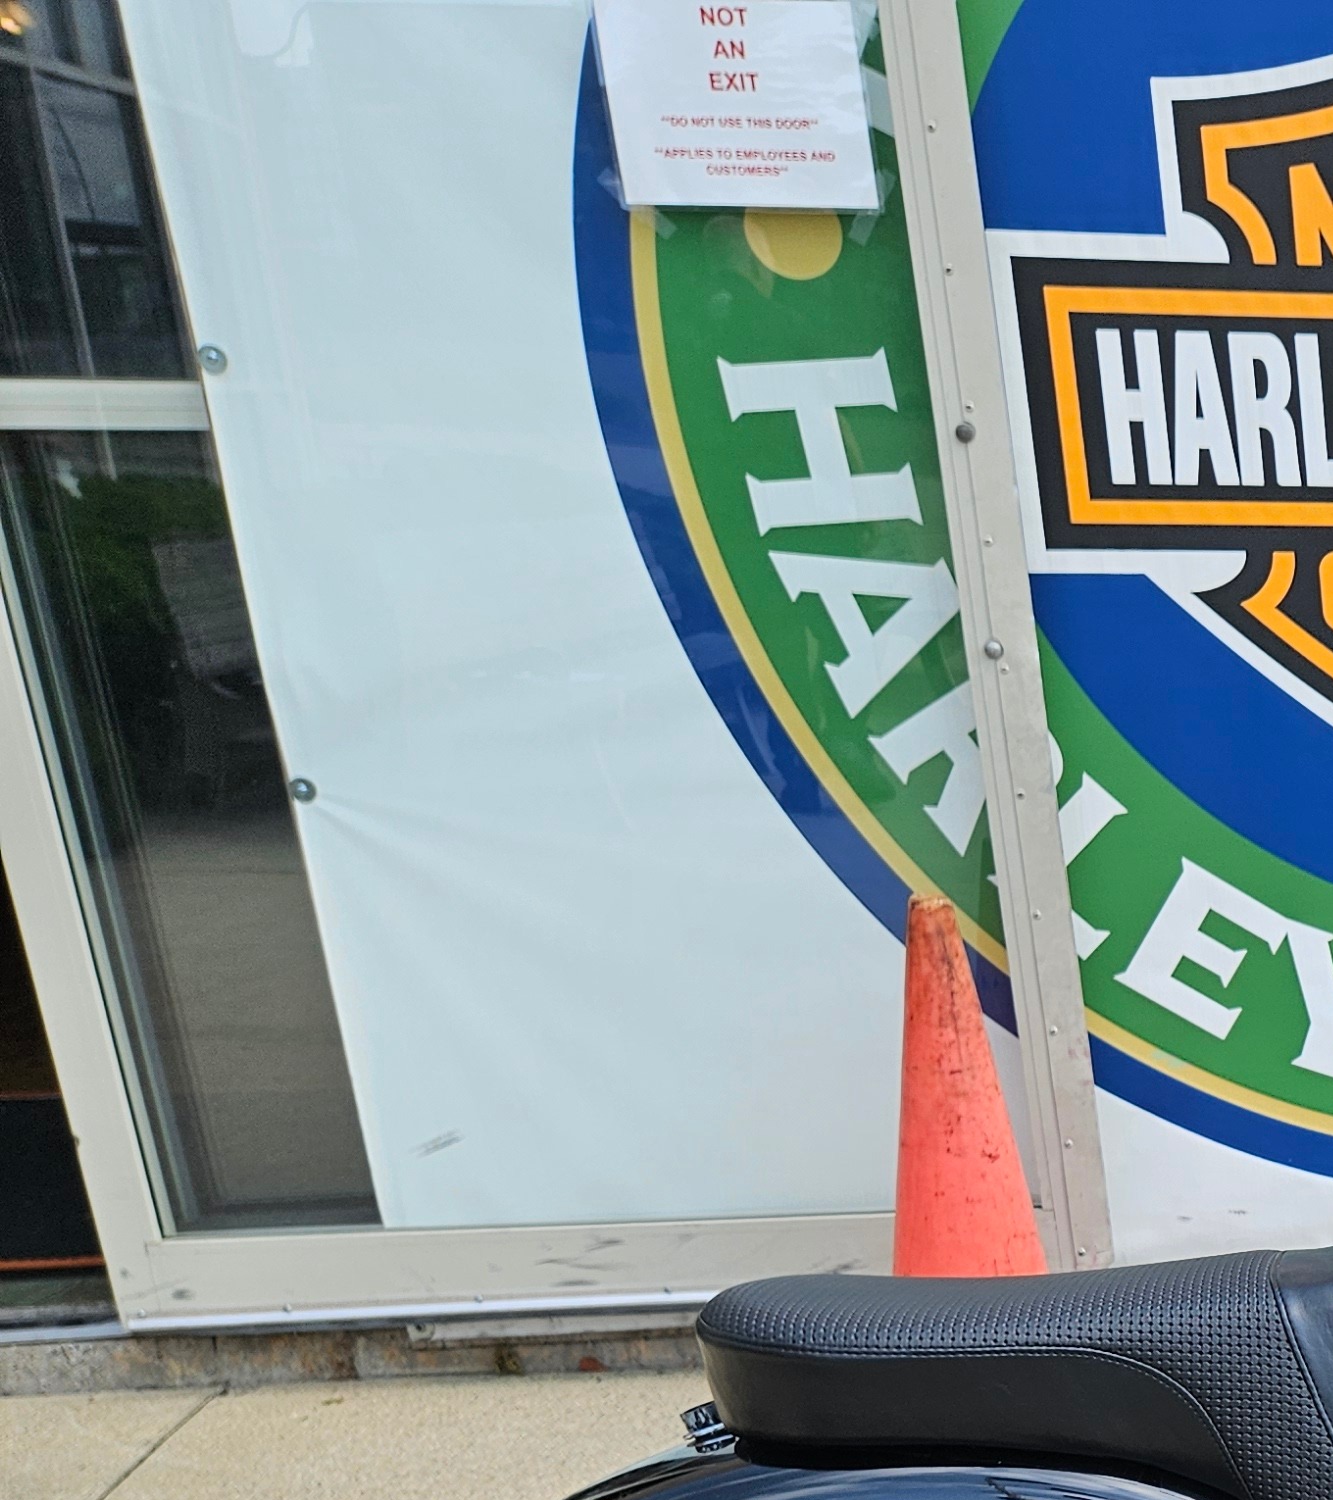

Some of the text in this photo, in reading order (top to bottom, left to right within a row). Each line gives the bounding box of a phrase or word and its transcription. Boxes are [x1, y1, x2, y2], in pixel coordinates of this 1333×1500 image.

[699, 7, 747, 27] NOT
[713, 40, 745, 60] AN
[708, 72, 759, 92] EXIT
[691, 116, 714, 128] NOT
[718, 116, 743, 129] USE
[746, 117, 772, 129] THIS
[716, 149, 732, 160] TO
[735, 149, 807, 162] EMPLOYEES
[811, 150, 836, 162] AND
